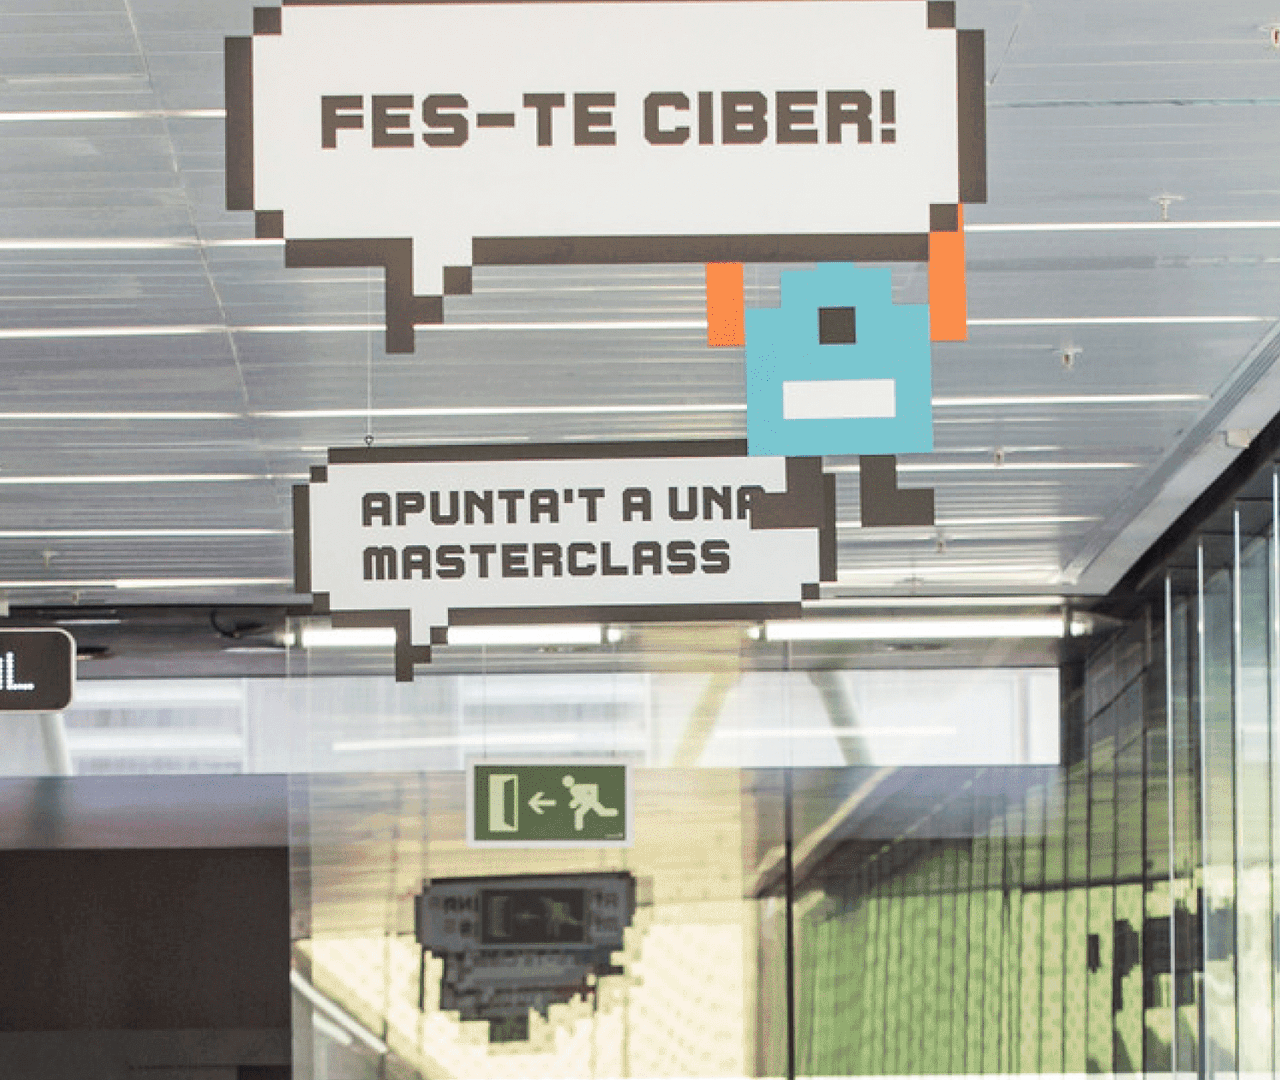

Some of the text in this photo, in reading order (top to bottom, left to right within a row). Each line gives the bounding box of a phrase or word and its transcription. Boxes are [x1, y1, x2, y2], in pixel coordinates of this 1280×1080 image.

[320, 89, 897, 149] FES-TE CIBER!
[361, 484, 766, 527] APUNTA'T A UNA
[363, 539, 731, 581] MASTERCLASS
